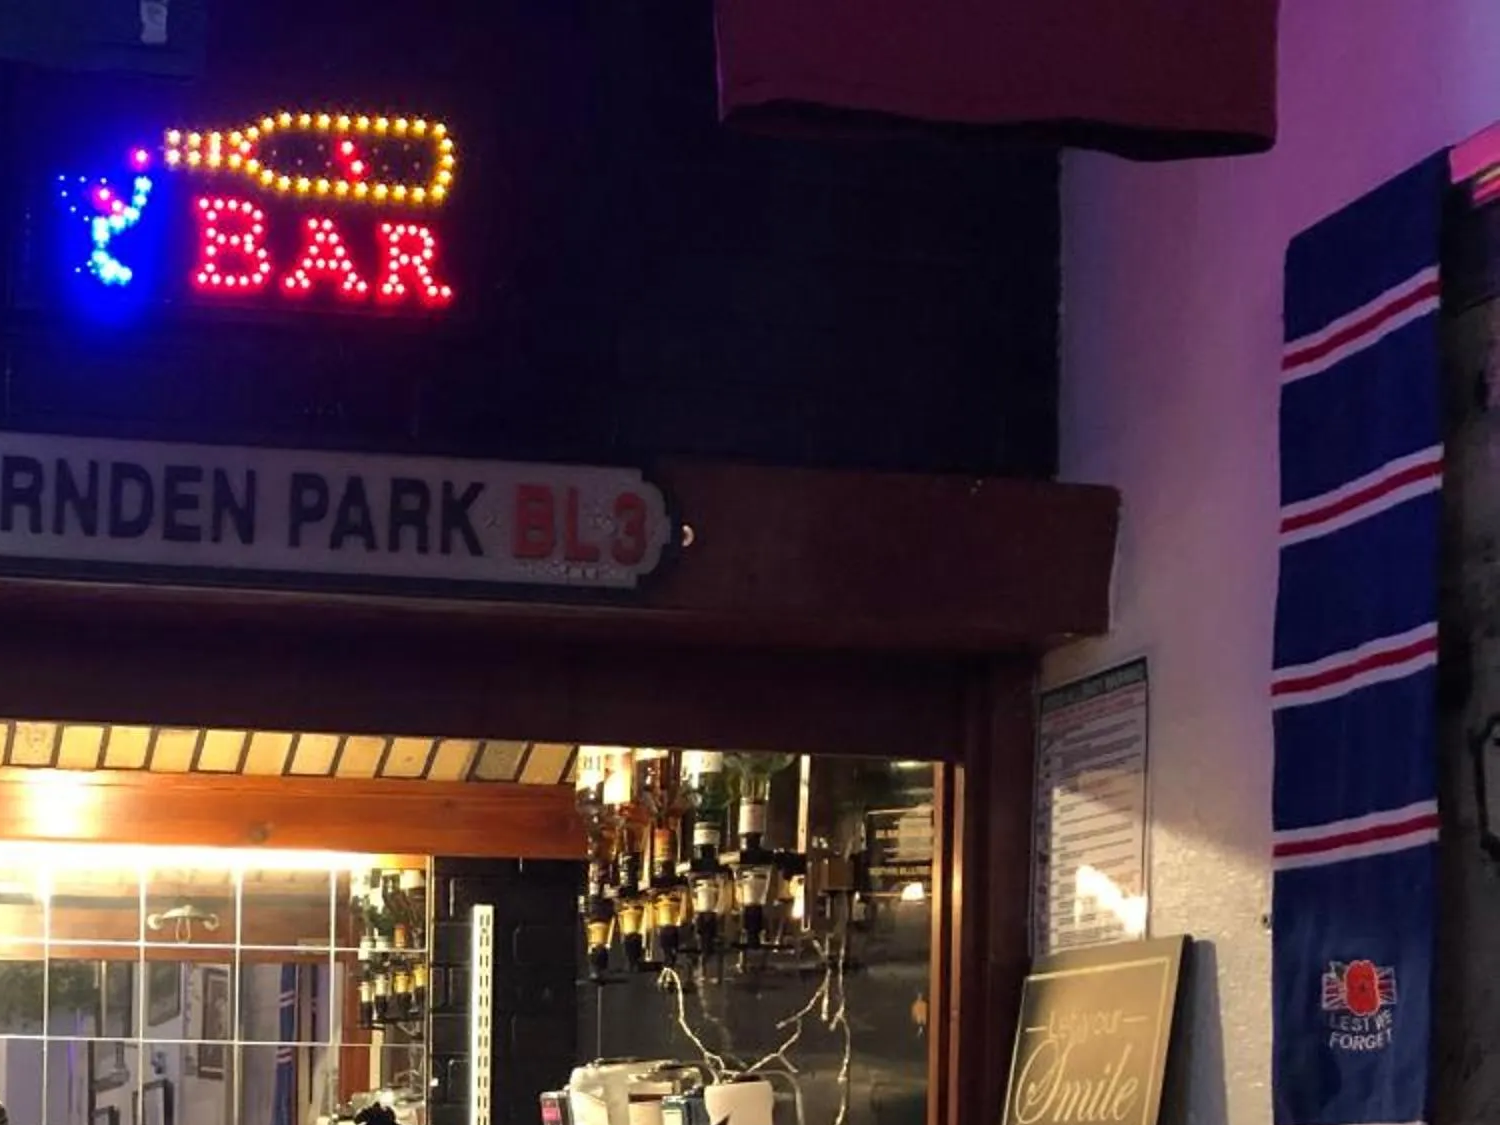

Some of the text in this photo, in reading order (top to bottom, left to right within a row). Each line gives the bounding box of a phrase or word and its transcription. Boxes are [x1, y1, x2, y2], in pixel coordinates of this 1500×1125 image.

[196, 197, 453, 298] BAR
[288, 472, 488, 558] PARK
[511, 483, 649, 566] BL3
[1329, 1012, 1370, 1032] LEST
[1329, 1028, 1392, 1050] FORGET
[1015, 1038, 1139, 1124] Smile
